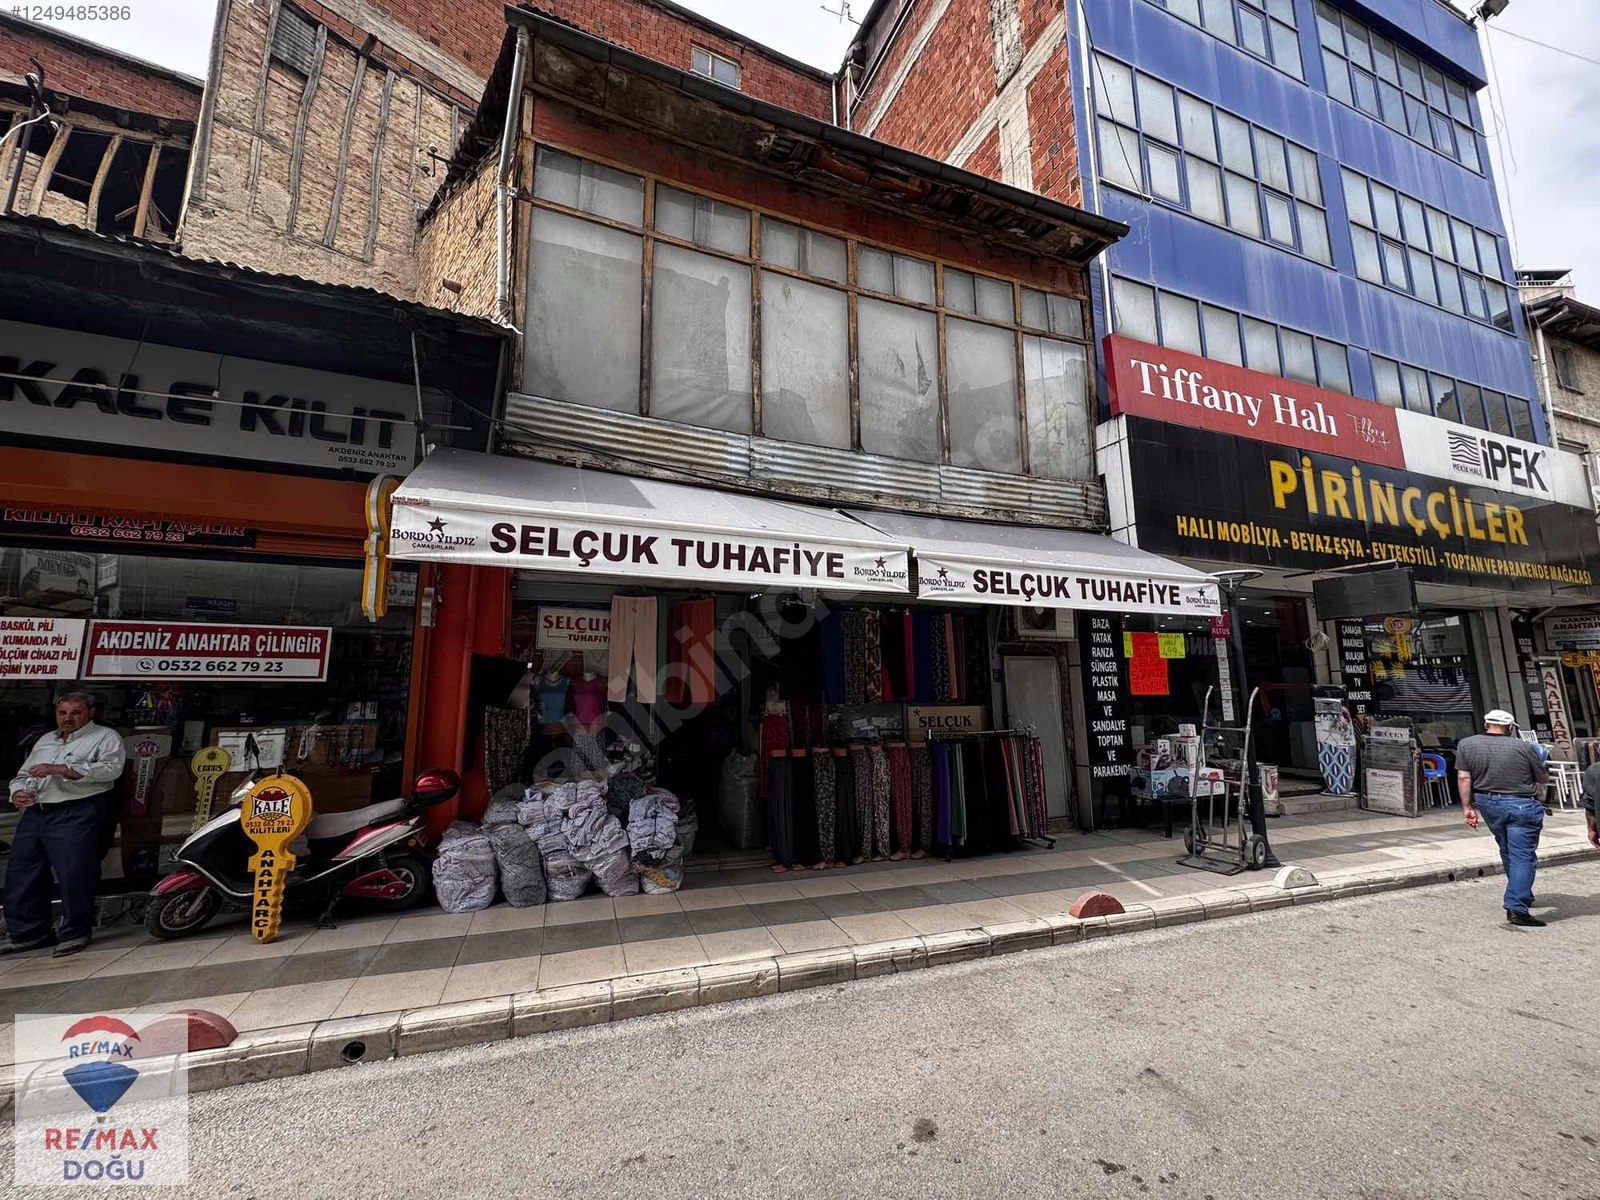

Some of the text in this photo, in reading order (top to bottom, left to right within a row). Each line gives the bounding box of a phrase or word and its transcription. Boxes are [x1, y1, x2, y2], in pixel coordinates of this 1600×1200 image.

[0, 356, 213, 426] KALE
[1130, 358, 1339, 437] Tiffany Halı
[338, 455, 357, 464] 0532
[359, 458, 373, 466] 662
[367, 451, 408, 462] ANAHTAR
[1452, 462, 1469, 474] MEKİK
[1269, 455, 1529, 546] PİRİNÇÇİLER
[71, 526, 185, 542] 0532 662 79 23
[391, 528, 475, 546] BORDO YILDIZ
[489, 522, 845, 579] SELÇUK TUHAFİYE
[1176, 515, 1593, 586] HALI MOBİLYA BEYAZ EŞYA EV TEKSTİLİ TOPTAN VE PARAKENDE MAĞAZASI
[853, 566, 880, 577] BORDO
[918, 576, 942, 586] BORDO
[972, 569, 1181, 605] SELÇUK TUHAFİYE
[1, 618, 54, 632] BASKÜL PİLİ
[1092, 618, 1110, 629] BAZA
[3, 634, 67, 646] KUMANDA PİLİ
[97, 627, 322, 657] AKDENİZ ANAHTAR ÇİLİNGİR
[567, 633, 611, 643] TUHAFİY
[1092, 633, 1112, 644] YATAK
[30, 648, 60, 661] CİHAZI
[62, 649, 77, 661] PİLİ
[1091, 647, 1114, 658] RANZA
[24, 664, 58, 675] YAPILIR
[158, 659, 284, 673] 0532 662 79 23
[1091, 659, 1117, 672] SÜNGER
[1092, 674, 1119, 687] PLASTİK
[1353, 678, 1362, 687] TV
[1097, 690, 1117, 702] MASA
[1348, 691, 1372, 700] ANKASTRE
[1103, 706, 1113, 716] VE
[1356, 704, 1366, 714] SET
[918, 714, 972, 729] SELÇUK
[1092, 720, 1126, 732] SANDALYE
[1097, 735, 1124, 747] TOPTAN
[1107, 750, 1117, 761] VE
[1093, 764, 1132, 778] PARAKENDE
[253, 798, 290, 815] KALE
[245, 820, 262, 828] 0532
[254, 850, 275, 938] ANAHTARCI
